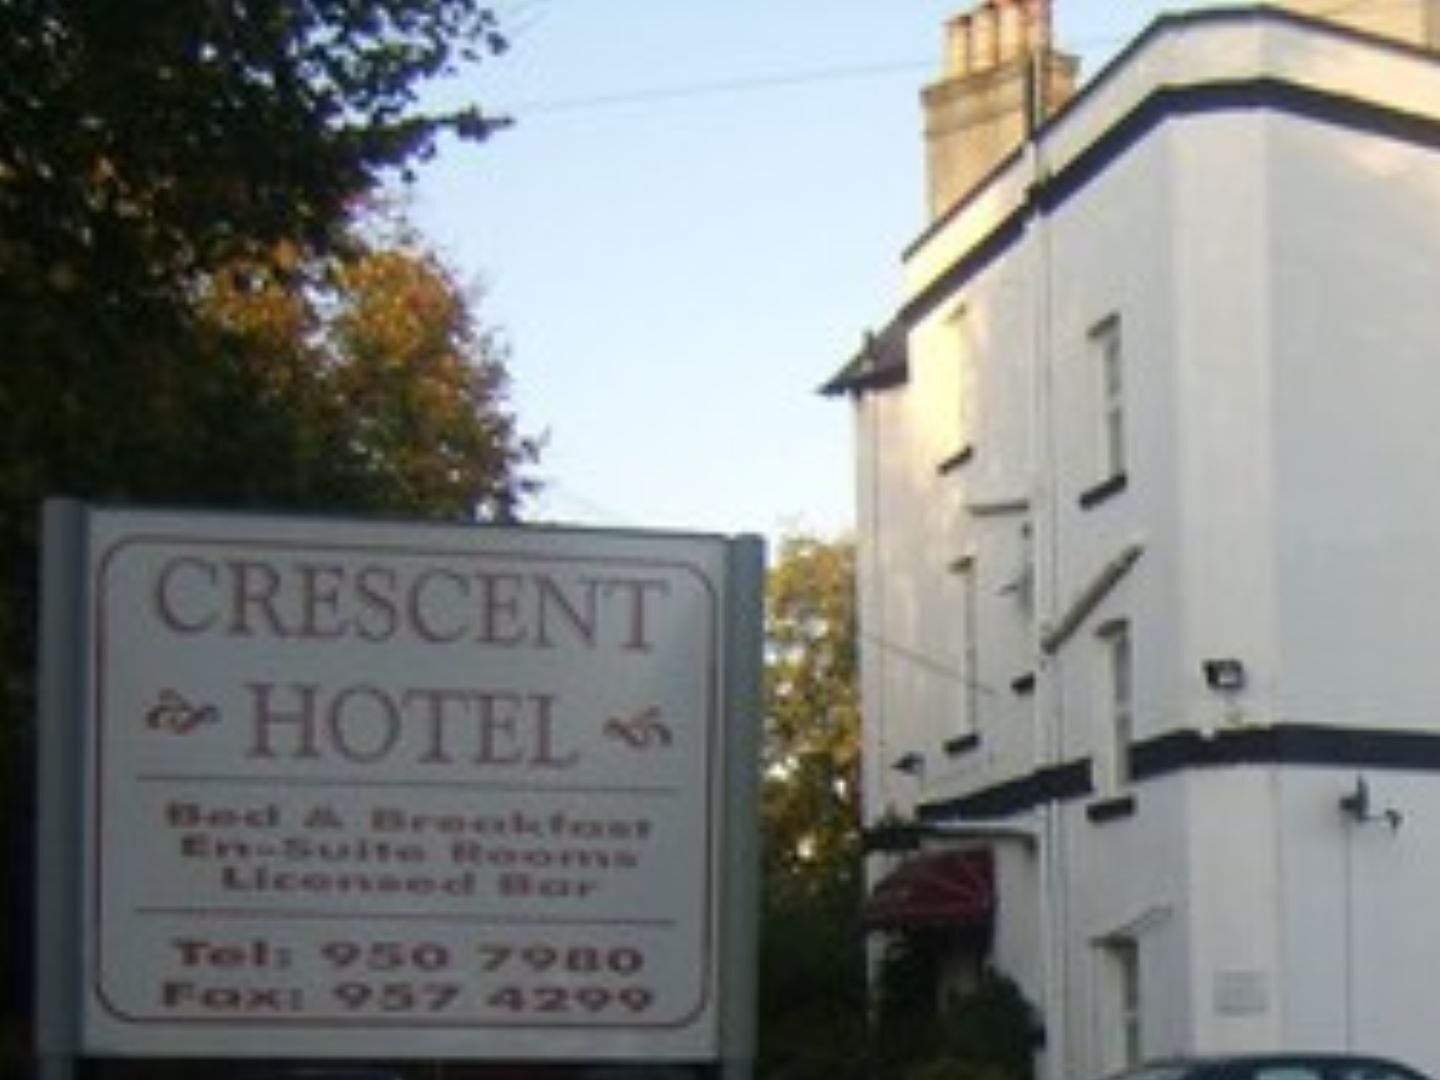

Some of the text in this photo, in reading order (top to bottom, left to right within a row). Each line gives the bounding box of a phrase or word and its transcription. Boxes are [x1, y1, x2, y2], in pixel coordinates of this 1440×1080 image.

[155, 556, 669, 651] CRESCENT
[243, 683, 580, 769] HOTEL
[165, 803, 651, 838] Bed & Breakfast
[181, 835, 638, 868] En-Suite Rooms
[221, 867, 597, 898] Licensed Bar
[173, 937, 643, 974] Tel: 950 7980
[162, 982, 652, 1013] Fax: 957 4299
